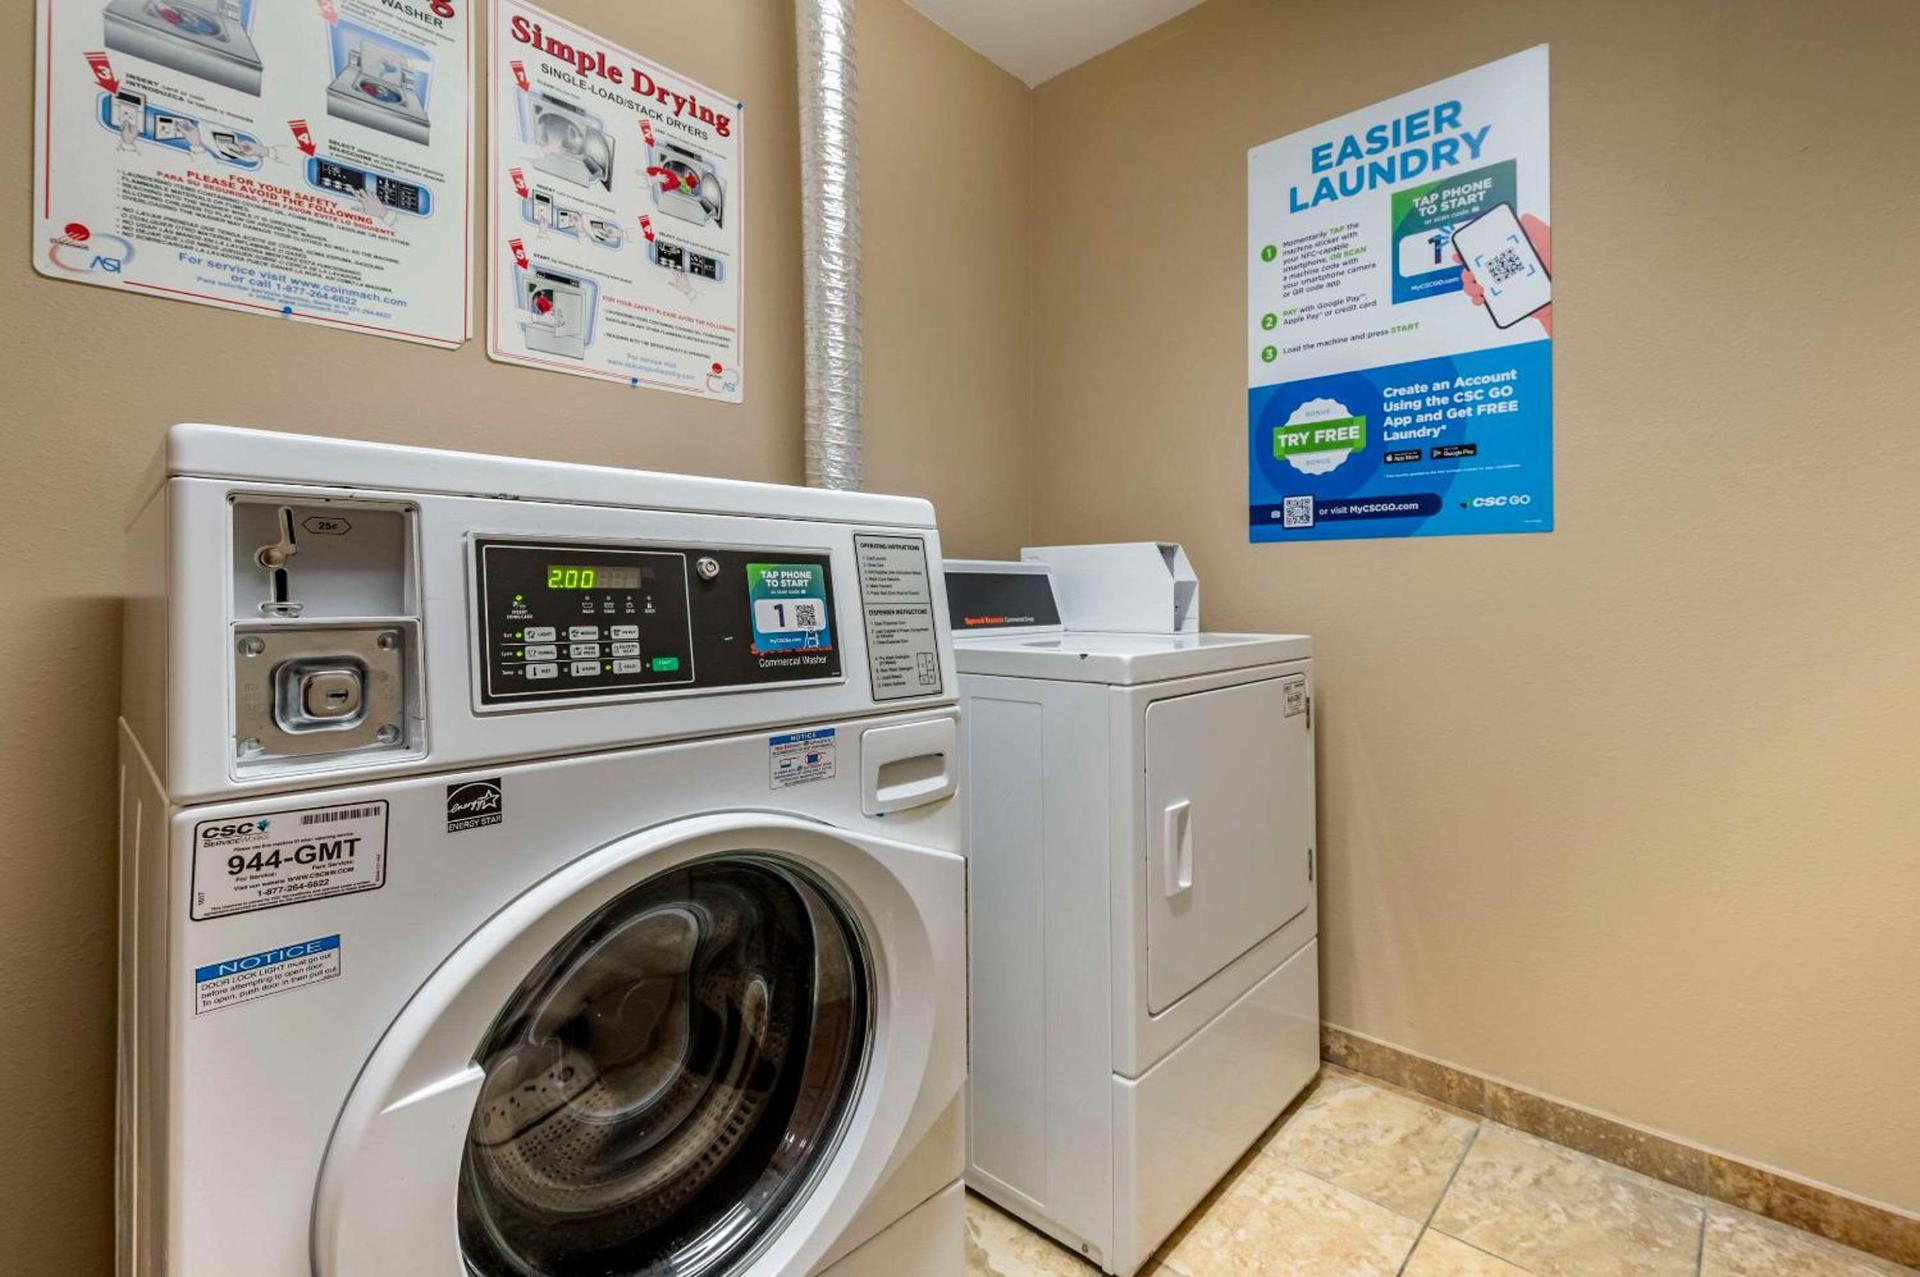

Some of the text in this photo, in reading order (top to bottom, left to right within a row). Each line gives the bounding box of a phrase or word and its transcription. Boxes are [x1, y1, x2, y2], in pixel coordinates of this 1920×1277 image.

[511, 15, 623, 85] Simple
[630, 67, 731, 138] Drying
[540, 62, 664, 123] SINGLE-LOAD/STACK
[666, 116, 709, 141] DRYERS
[1311, 100, 1462, 174] EASIER
[1290, 124, 1492, 214] LAUNDRY
[156, 170, 184, 182] PARA
[186, 179, 201, 188] SU
[282, 202, 312, 216] FAVOR
[314, 210, 337, 221] EVITE
[186, 170, 373, 225] PLEASE AVOID THE FOLLOWING
[229, 174, 338, 208] FOR YOUR SAFETY
[1412, 177, 1493, 208] TAP PHONE
[1418, 190, 1487, 217] TO START
[1282, 231, 1358, 257] machine sticker with
[1283, 222, 1360, 247] Momentarily TAP the
[1265, 247, 1272, 259] 1
[1283, 243, 1349, 266] your NFC-capable
[1329, 252, 1342, 261] OR
[1344, 246, 1367, 258] SCAN
[1428, 234, 1442, 264] 1
[178, 252, 407, 307] For service visit www.coinmach.com
[1283, 262, 1377, 291] your smartphone camera
[1289, 268, 1319, 280] machine
[1321, 262, 1340, 273] code
[1342, 257, 1359, 267] with
[231, 275, 358, 306] or call 1-877-264-6622
[1292, 287, 1304, 297] QR
[1306, 283, 1324, 293] code
[1326, 279, 1341, 290] app
[1283, 298, 1345, 317] PAY with Google
[1283, 316, 1304, 326] Apple
[1335, 304, 1357, 315] credit
[1359, 299, 1377, 309] card
[1265, 316, 1273, 328] 2
[1283, 321, 1420, 355] Load the machine and press START
[1265, 348, 1274, 360] 3
[1383, 368, 1518, 398] Create an Account
[1383, 384, 1514, 413] Using the CSC GO
[1383, 399, 1519, 429] App and Get FREE
[1277, 425, 1361, 447] TRY FREE
[1443, 449, 1463, 457] Google
[1463, 448, 1475, 456] Play
[1319, 502, 1419, 515] or visit MyCSCGO.com
[1473, 494, 1531, 507] CSC GO
[548, 570, 594, 588] 2.00
[760, 571, 812, 579] TAP PHONE
[780, 579, 809, 587] START
[773, 603, 785, 627] 1
[759, 655, 827, 668] Commercial Washer
[201, 822, 254, 839] CSC
[448, 815, 502, 831] ENERGY STAR
[227, 838, 362, 876] 944-GMT
[201, 952, 332, 991] DOOR LOCK LIGHT must go out
[219, 941, 323, 976] NOTICE
[201, 987, 228, 999] before
[230, 976, 273, 993] attempting
[284, 968, 304, 979] open
[202, 1000, 212, 1008] To
[213, 993, 238, 1005] open,
[239, 987, 260, 999] push
[261, 981, 280, 991] door
[281, 978, 289, 986] in
[291, 973, 308, 983] then
[309, 969, 323, 979] pull
